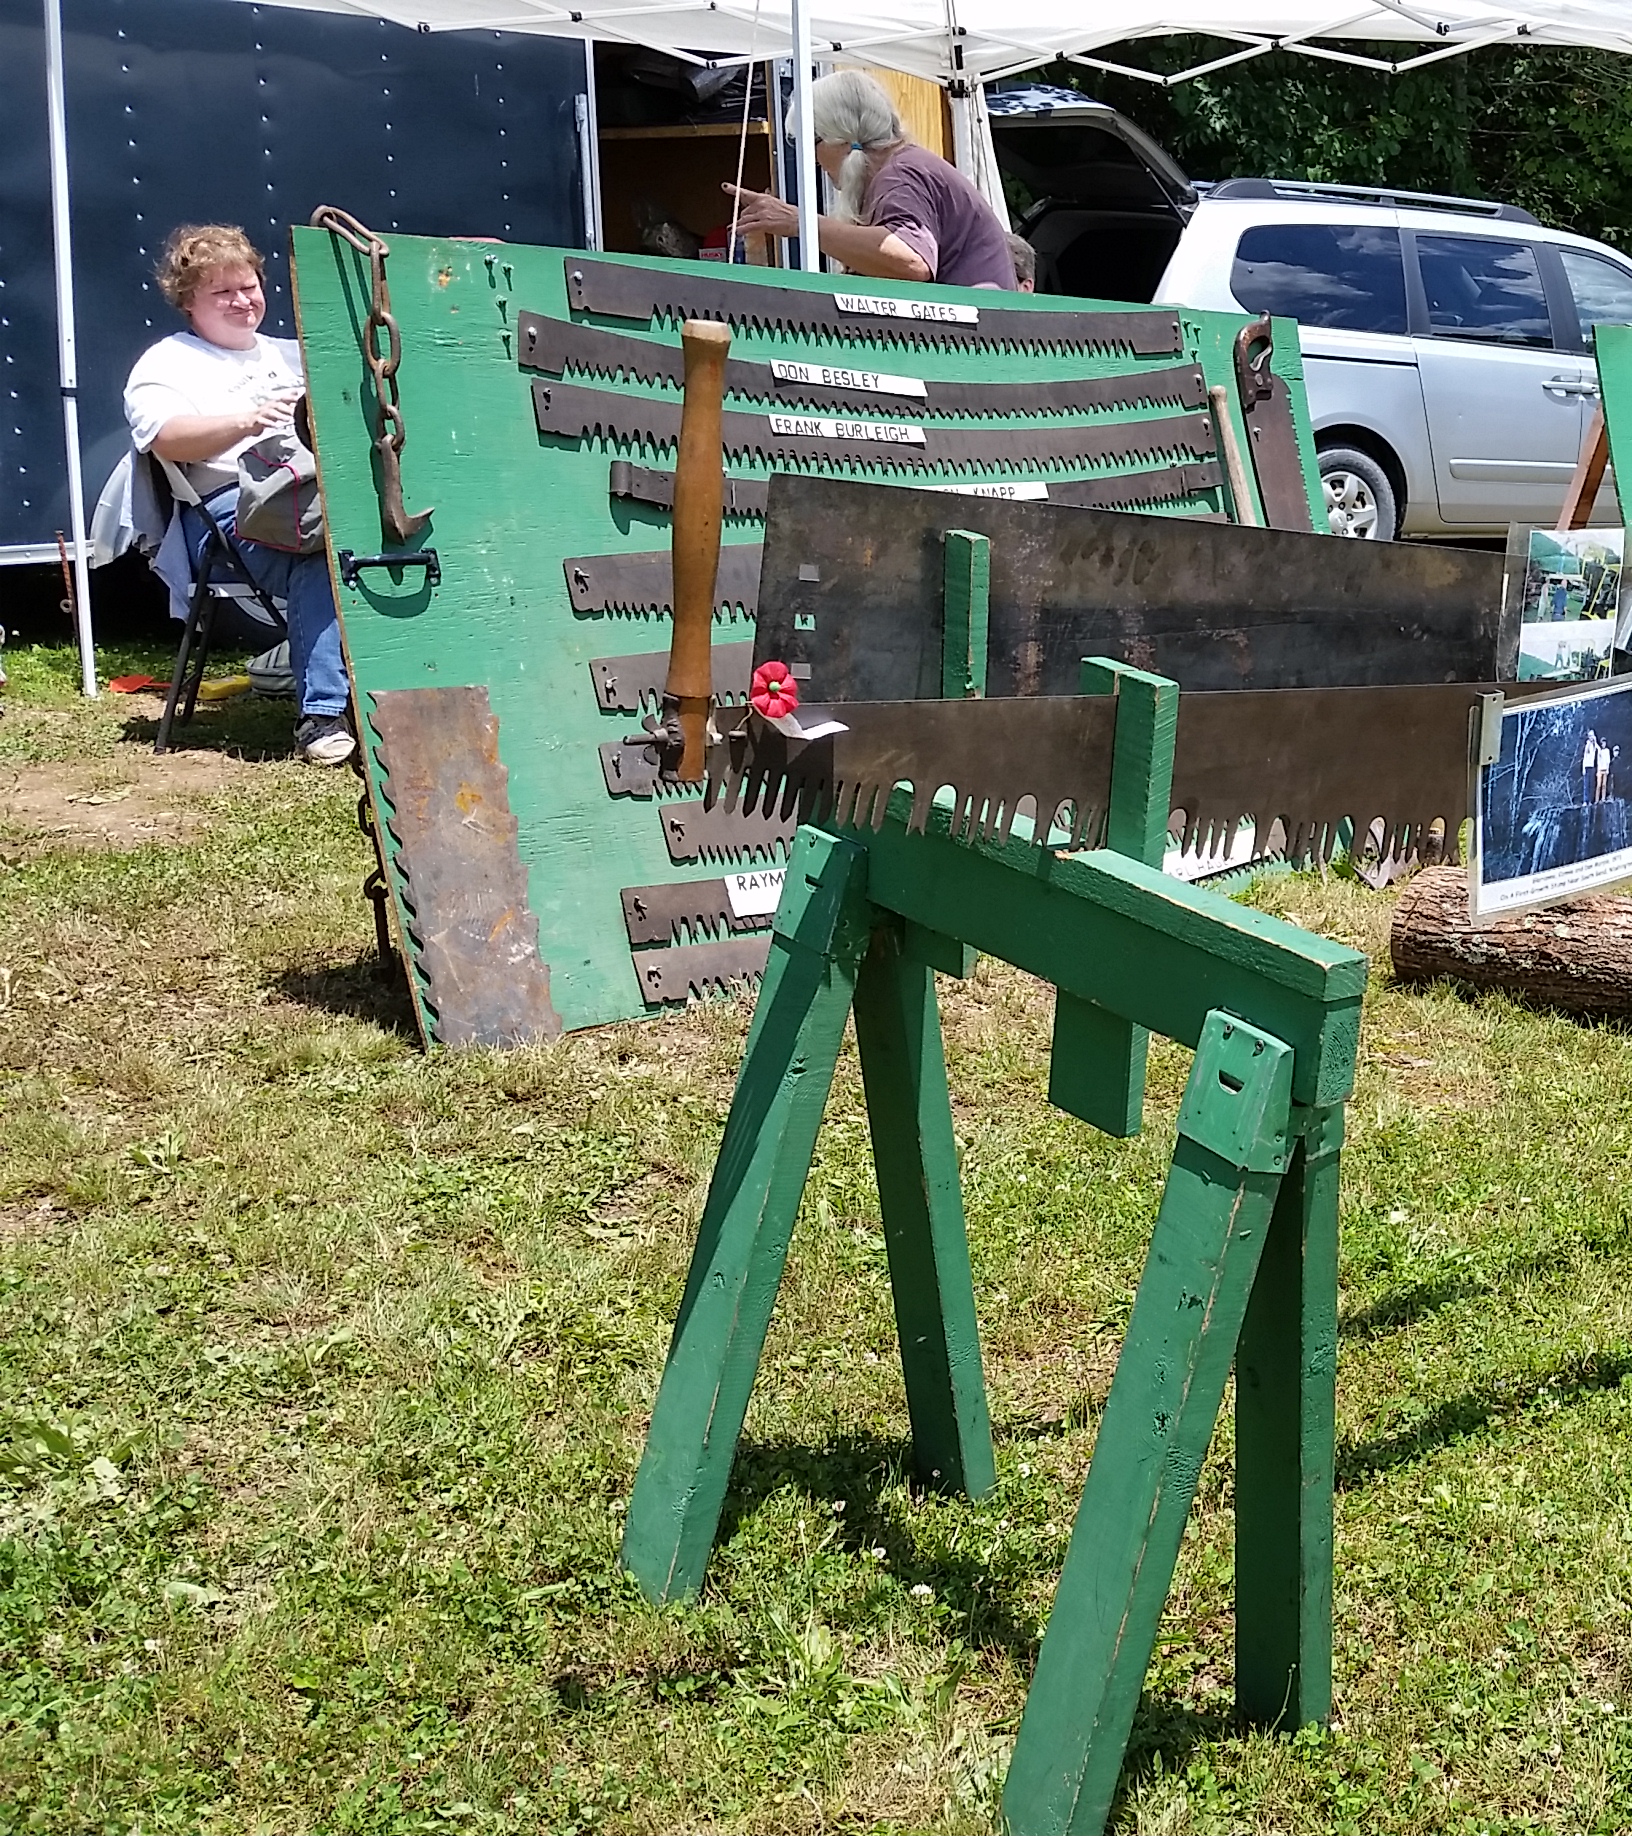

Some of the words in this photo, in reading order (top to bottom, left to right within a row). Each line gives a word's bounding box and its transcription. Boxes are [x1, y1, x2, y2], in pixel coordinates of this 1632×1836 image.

[839, 296, 898, 317] WALTER
[911, 303, 957, 321] GATES
[777, 363, 810, 381] DON
[821, 368, 880, 389] BESLEY
[775, 418, 823, 437] FRANK
[835, 422, 910, 441] BURLEIGH
